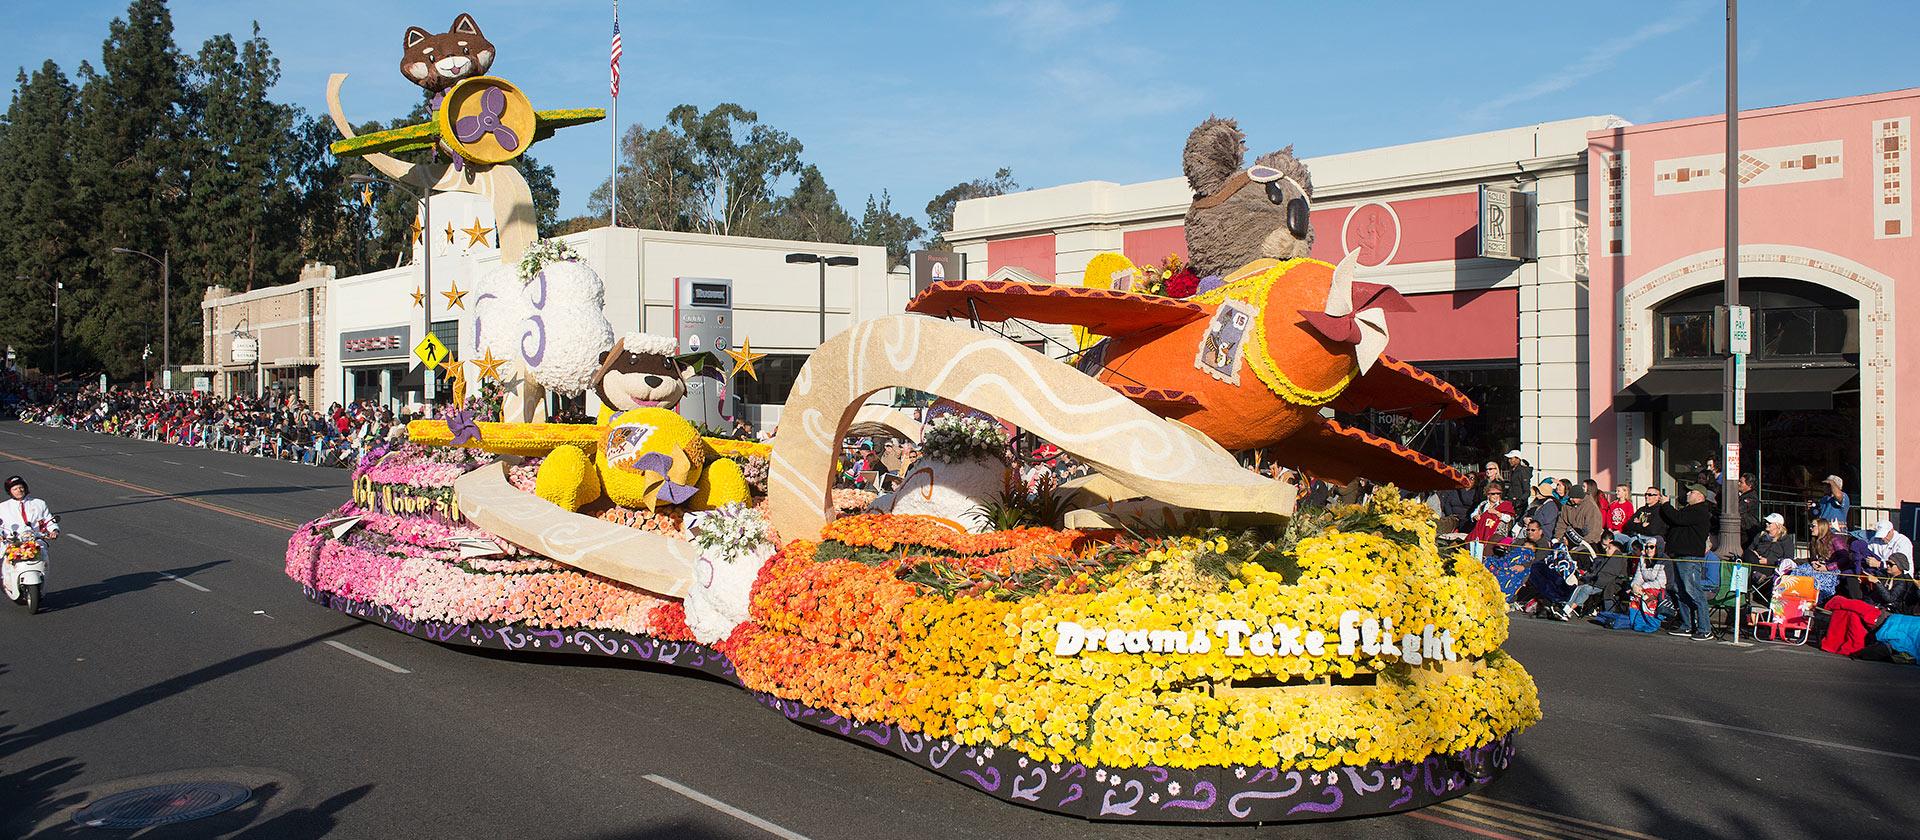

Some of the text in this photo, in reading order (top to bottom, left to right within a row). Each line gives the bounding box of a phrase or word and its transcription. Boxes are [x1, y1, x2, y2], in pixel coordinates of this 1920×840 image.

[1735, 320, 1746, 330] PAY
[1734, 331, 1747, 341] HERE
[1054, 621, 1212, 656] Dreams
[1216, 619, 1325, 656] Take
